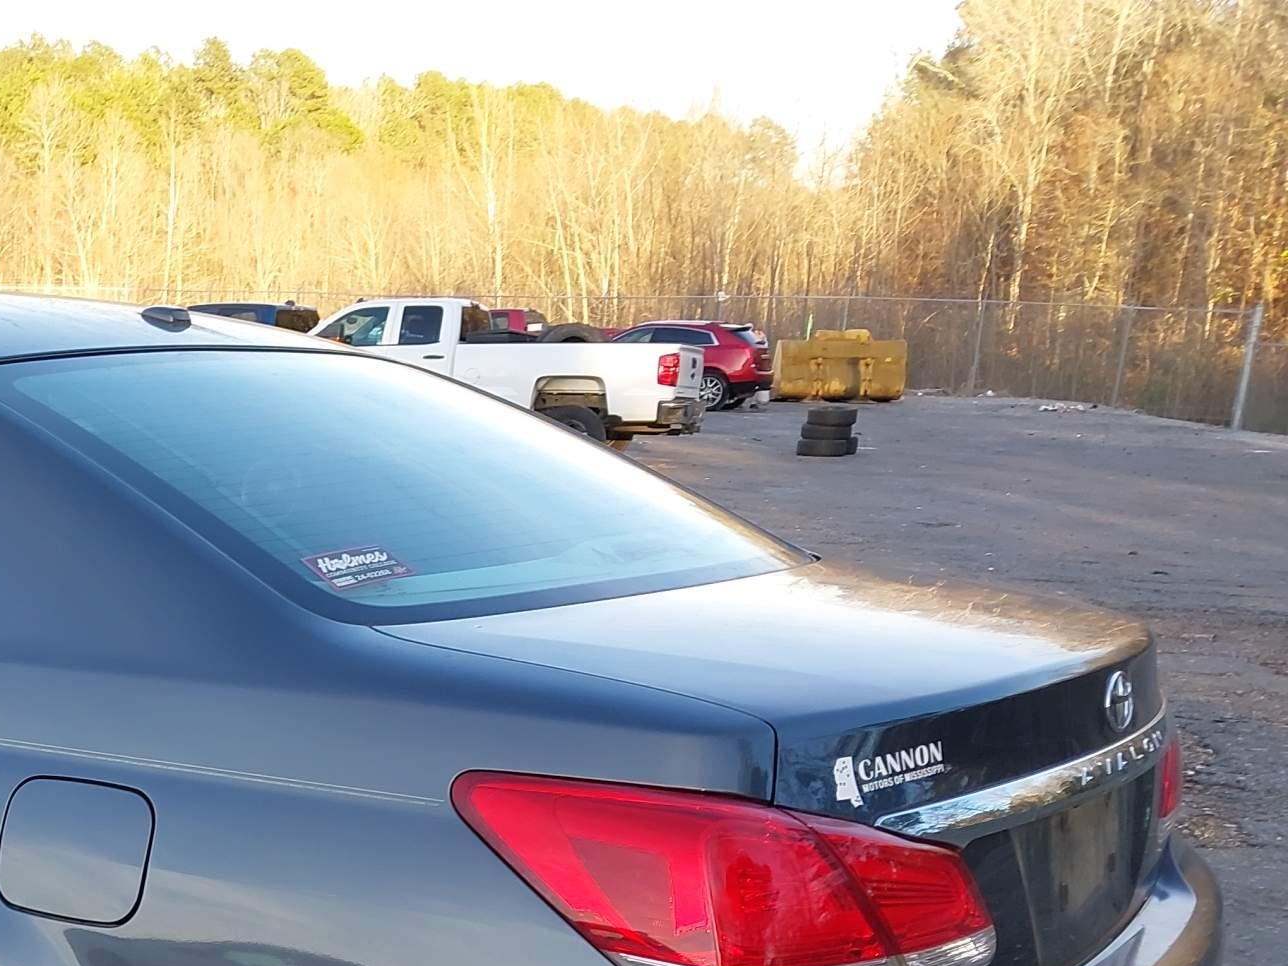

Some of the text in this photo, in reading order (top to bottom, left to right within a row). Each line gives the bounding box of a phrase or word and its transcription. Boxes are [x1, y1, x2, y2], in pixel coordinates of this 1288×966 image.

[858, 740, 944, 781] CANNON
[861, 778, 894, 793] MOTORS
[893, 773, 905, 785] OF
